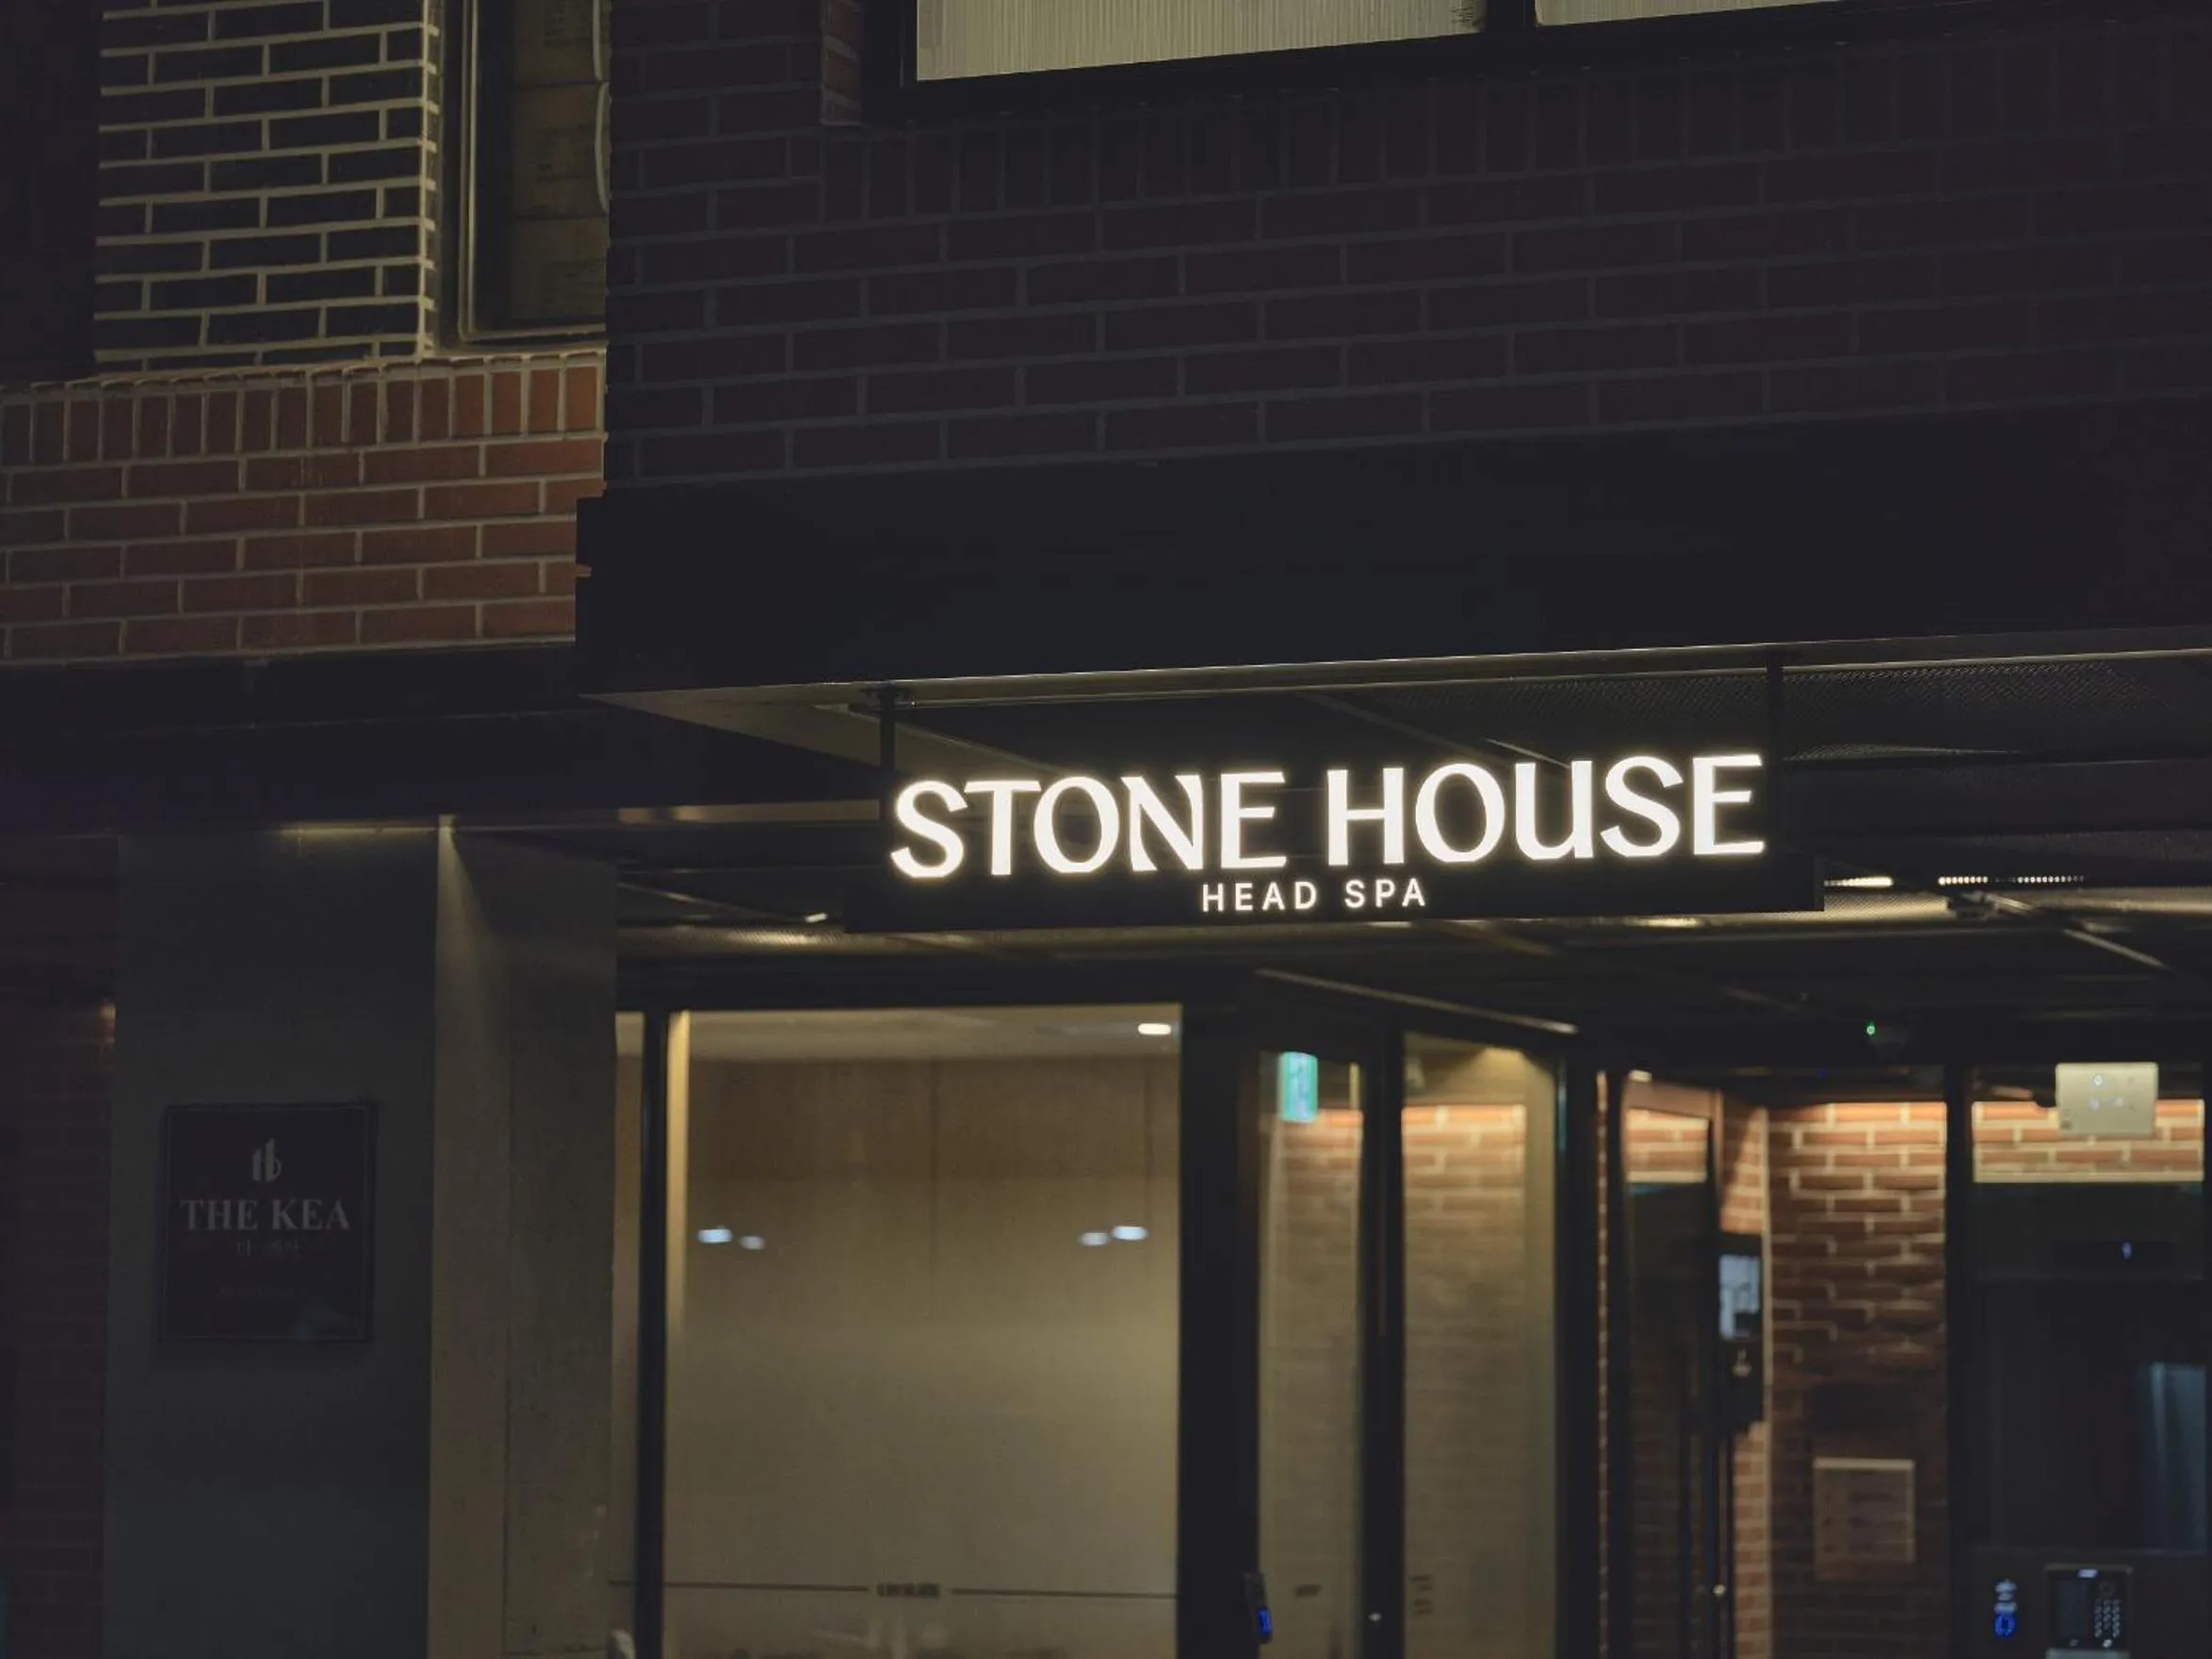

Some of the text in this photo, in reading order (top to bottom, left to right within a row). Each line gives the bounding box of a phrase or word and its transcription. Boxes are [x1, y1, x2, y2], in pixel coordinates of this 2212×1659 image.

[889, 753, 1766, 880] STONE HOUSE
[1201, 877, 1427, 914] HEAD SPA
[180, 1198, 351, 1230] THE KEA
